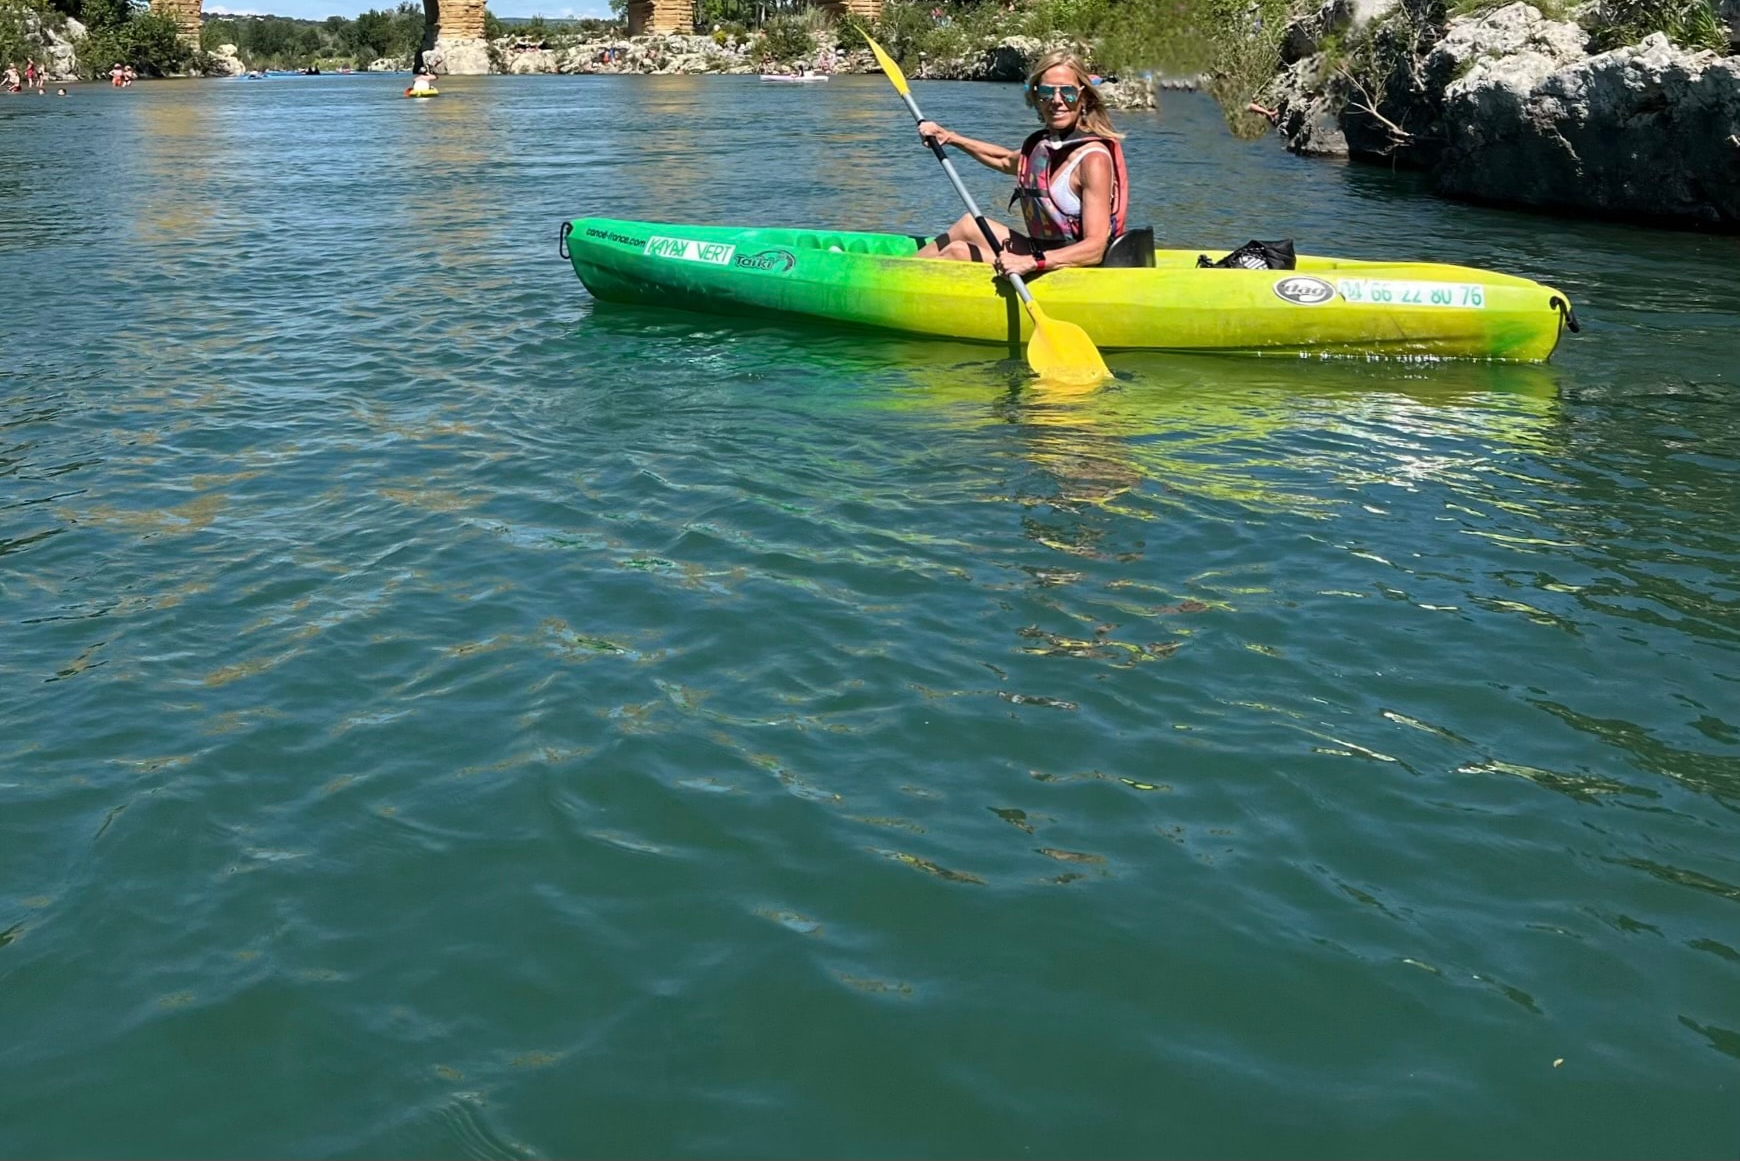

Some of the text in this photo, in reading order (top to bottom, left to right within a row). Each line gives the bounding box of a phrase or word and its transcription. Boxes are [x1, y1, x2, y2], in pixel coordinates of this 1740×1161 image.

[647, 238, 732, 263] KAYAK VERT
[735, 254, 775, 270] Taiki
[1370, 281, 1393, 303] 66
[1459, 285, 1483, 307] 76
